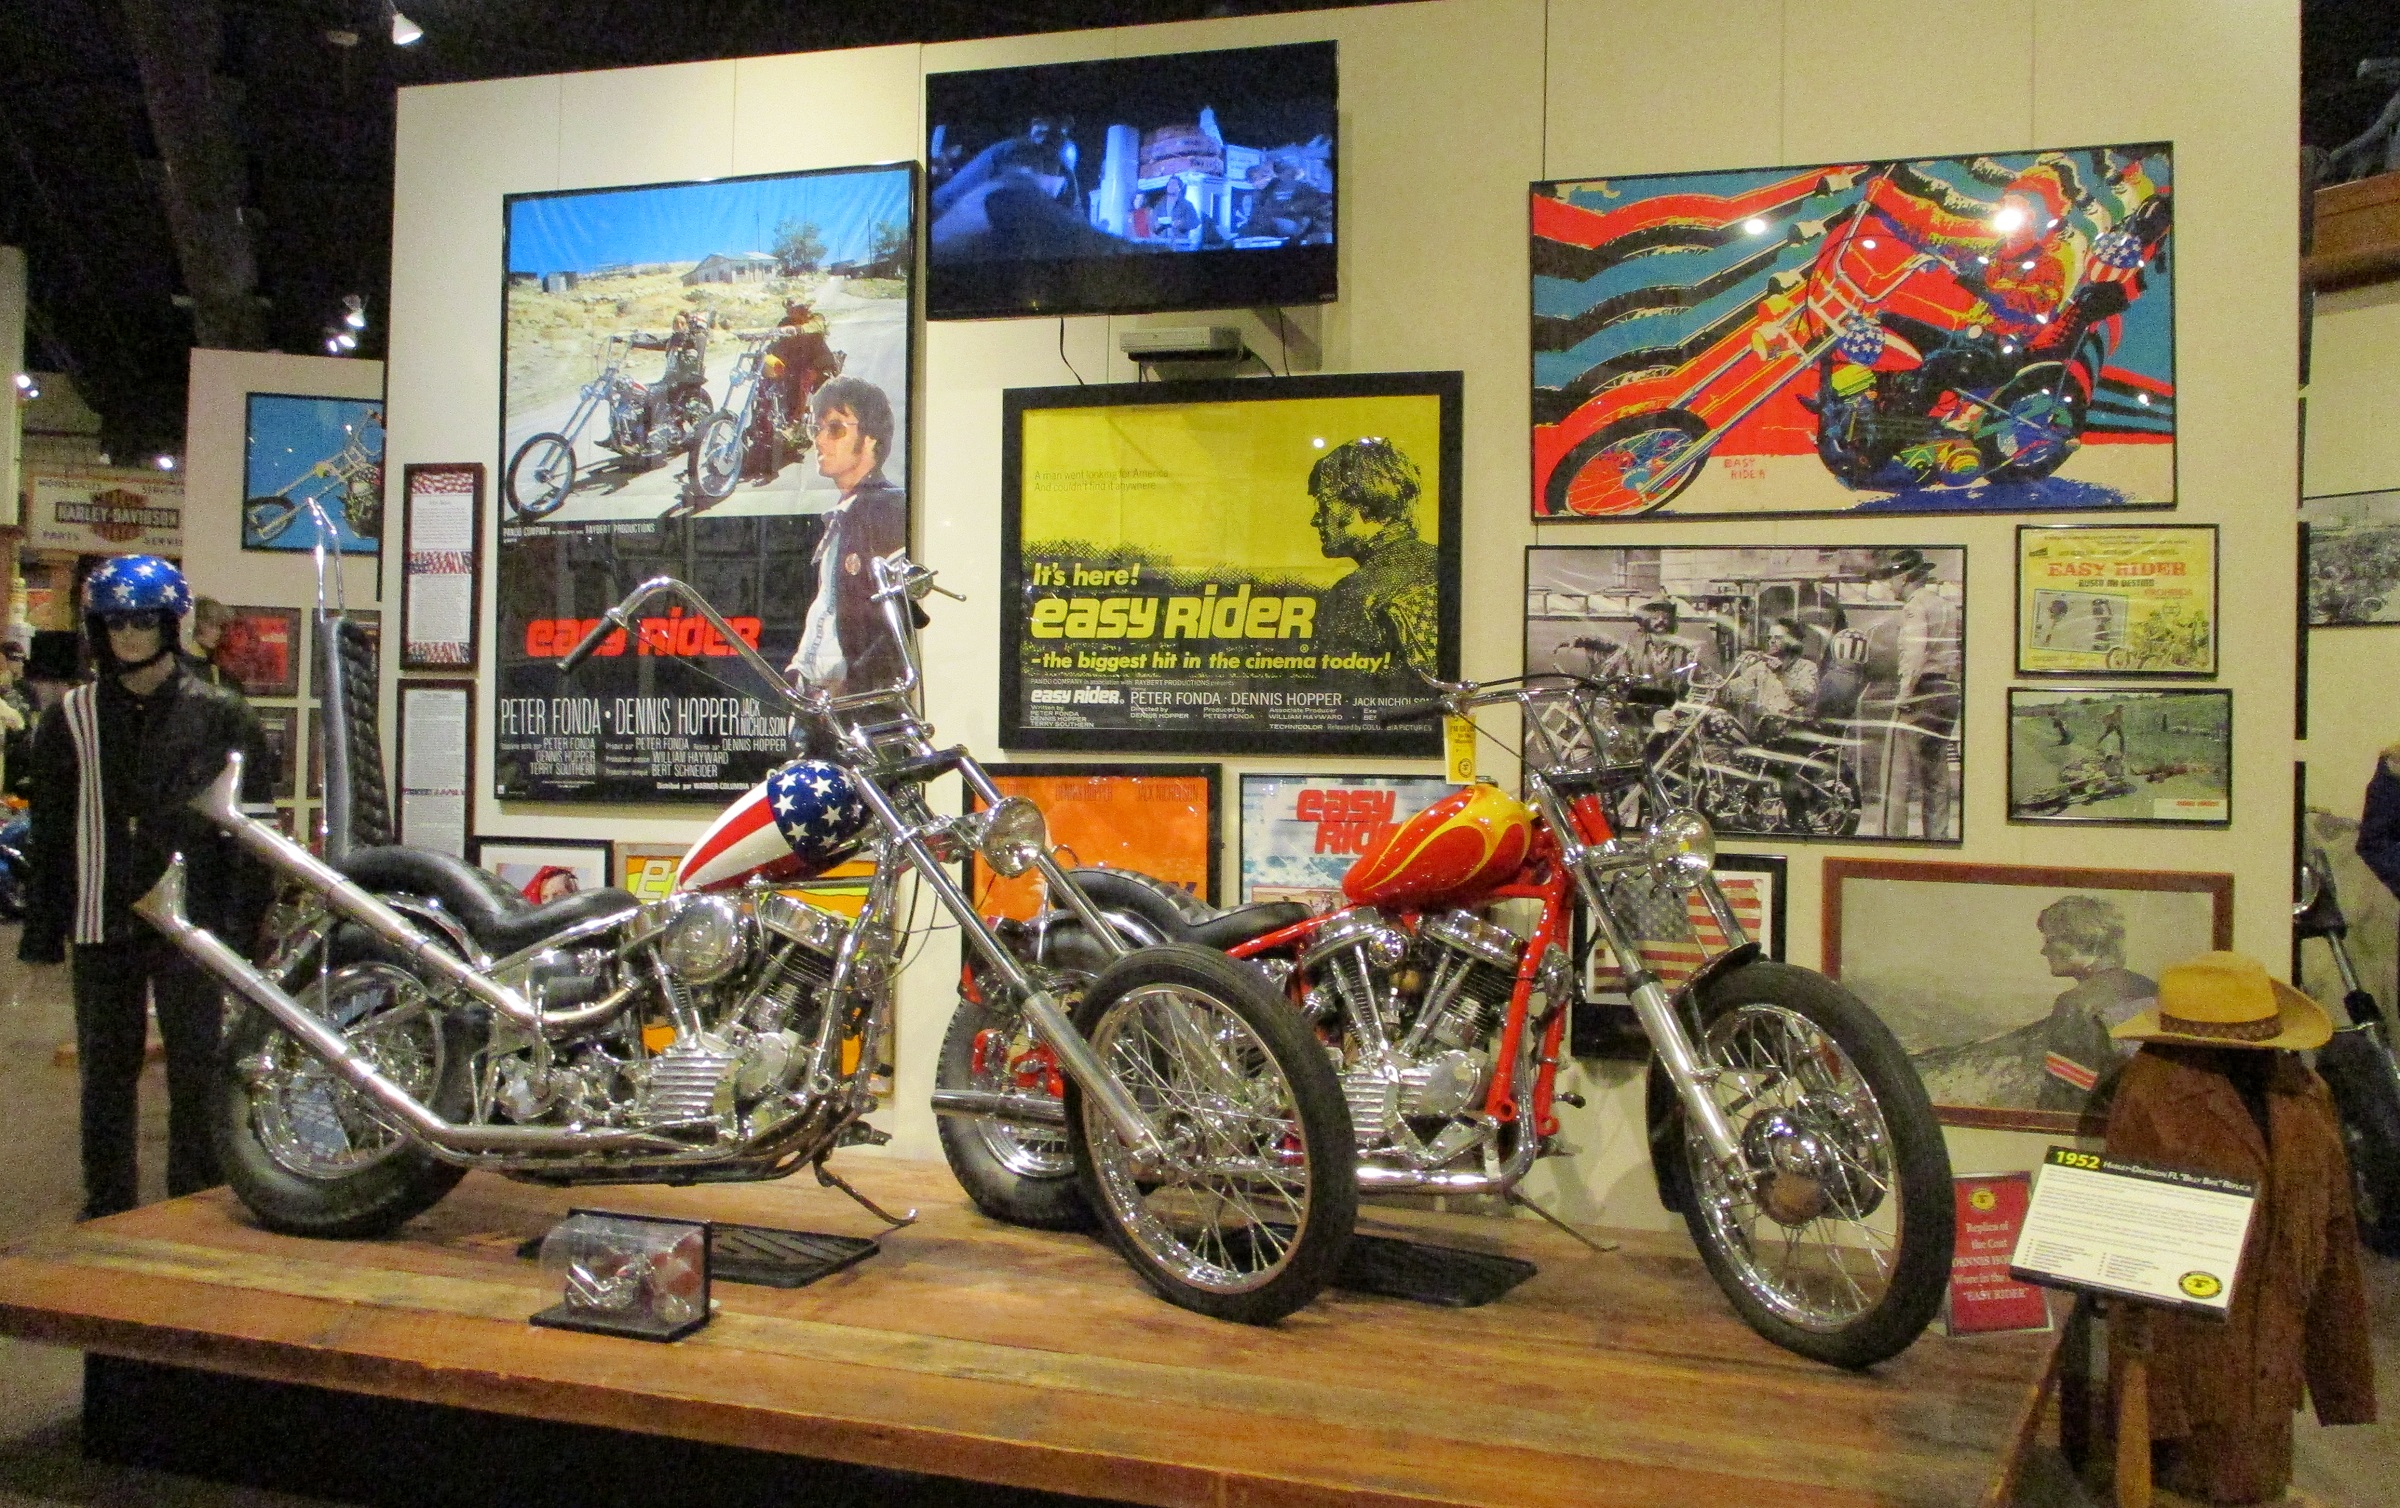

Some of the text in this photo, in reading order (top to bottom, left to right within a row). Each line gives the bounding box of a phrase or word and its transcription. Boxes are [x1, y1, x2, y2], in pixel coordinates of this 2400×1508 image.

[1034, 468, 1169, 482] A man went looking for America
[1034, 482, 1052, 492] And
[1089, 481, 1106, 491] find
[1108, 481, 1114, 491] it
[1115, 481, 1156, 493] anywhere
[57, 503, 179, 527] HARLEY-DAVIDSON
[613, 523, 656, 534] PRODUCTIONS
[1032, 562, 1141, 587] It's here!
[2047, 561, 2187, 577] EASY RIDER
[1031, 597, 1158, 639] easy
[1077, 652, 1148, 673] biggest
[1152, 652, 1178, 669] hit
[1183, 652, 1201, 669] in
[1209, 652, 1241, 670] the
[1244, 653, 1317, 670] cinema
[1320, 652, 1391, 673] today!
[1163, 679, 1211, 687] PRODUCTIONS
[1030, 689, 1072, 704] easy
[1130, 691, 1172, 705] PETER
[1175, 691, 1222, 706] FONDA
[1231, 692, 1283, 706] DENNIS
[1286, 692, 1343, 707] HOPPER
[1352, 697, 1377, 707] JACK
[740, 698, 761, 717] JACK
[1030, 704, 1057, 712] Written
[1158, 706, 1169, 714] by
[1203, 706, 1246, 715] Produced by
[500, 697, 740, 736] PETER FONDA DENNIS HOPPER
[740, 716, 787, 737] NICHOLSON
[1054, 721, 1095, 729] SOUTHERN
[1269, 723, 1324, 731] TECHNICOLOR
[1327, 723, 1354, 732] Released
[1399, 724, 1433, 732] PICTURES
[543, 737, 568, 750] PETER
[569, 737, 596, 750] FONDA
[635, 737, 662, 751] PETER
[662, 737, 690, 751] FONDA
[721, 738, 751, 751] DENNIS
[752, 738, 787, 752] HOPPER
[535, 750, 596, 763] DENNIS HOPPER
[652, 751, 687, 765] WILLIAM
[688, 751, 729, 765] HAYWARD
[530, 762, 596, 776] TERRY SOUTHERN
[651, 764, 672, 777] BERT
[673, 764, 718, 778] SCHNEIDER
[1296, 789, 1396, 822] easy
[2056, 1151, 2101, 1170] 1952
[1951, 1255, 1991, 1268] DENNIS
